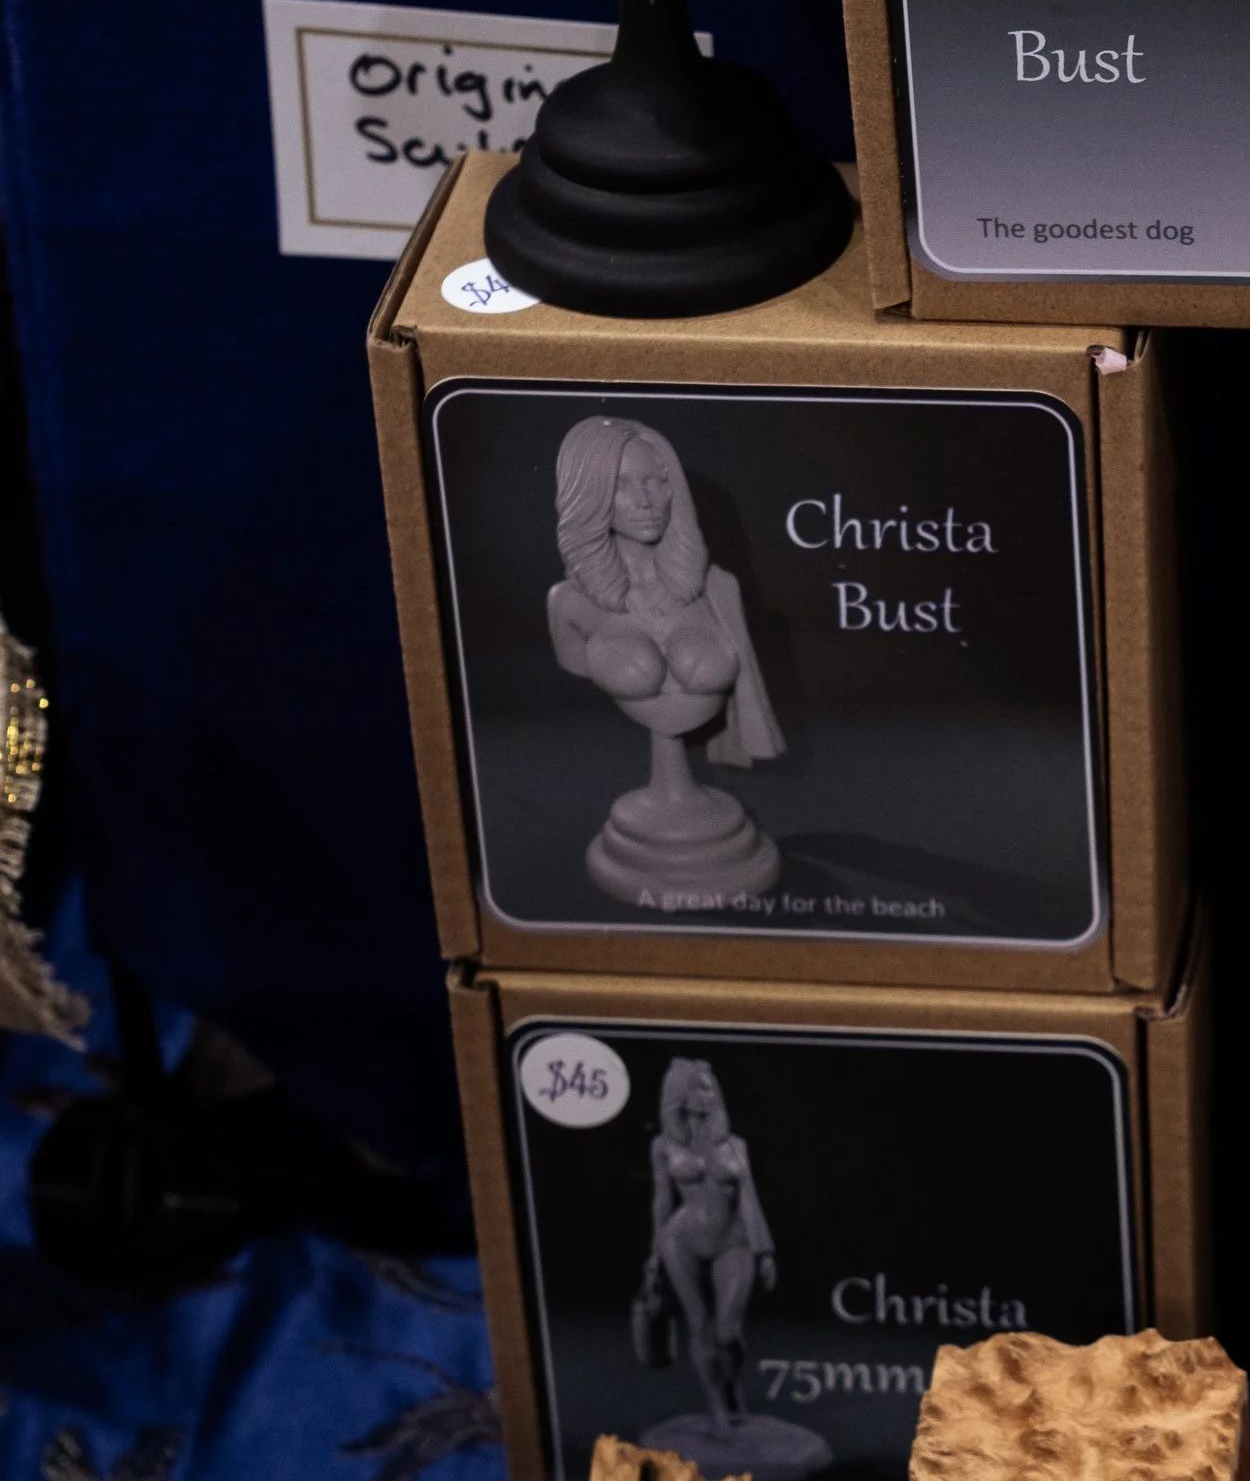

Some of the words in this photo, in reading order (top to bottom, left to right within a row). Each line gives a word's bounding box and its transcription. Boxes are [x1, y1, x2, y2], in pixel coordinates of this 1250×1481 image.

[1007, 29, 1147, 84] Bust
[976, 217, 1025, 239] The
[1033, 219, 1138, 244] goodest
[1146, 219, 1195, 246] dog
[786, 493, 1000, 554] Christa
[831, 581, 962, 633] Bust
[638, 889, 655, 907] A
[662, 891, 724, 914] great
[731, 890, 776, 917] day
[782, 893, 818, 914] for
[823, 894, 865, 916] the
[871, 895, 946, 919] beach
[538, 1060, 608, 1102] $45
[831, 1272, 1029, 1330] Christa
[757, 1357, 927, 1403] 75mm
